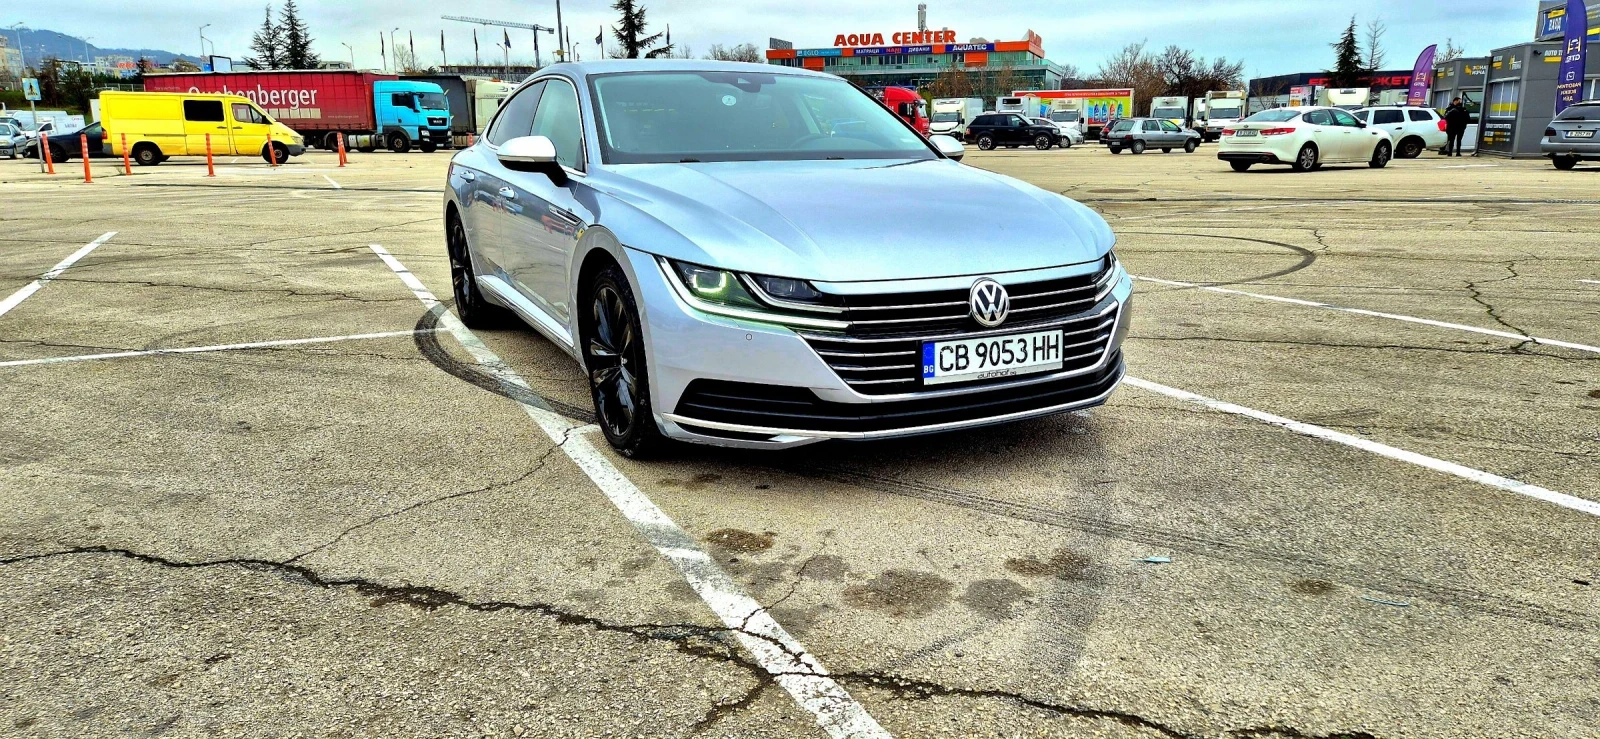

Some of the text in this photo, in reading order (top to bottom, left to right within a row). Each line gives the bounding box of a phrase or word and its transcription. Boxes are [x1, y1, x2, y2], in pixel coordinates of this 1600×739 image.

[834, 30, 956, 46] AQUA CENTER
[939, 334, 1059, 372] CB 9053 HH
[923, 365, 934, 374] BG
